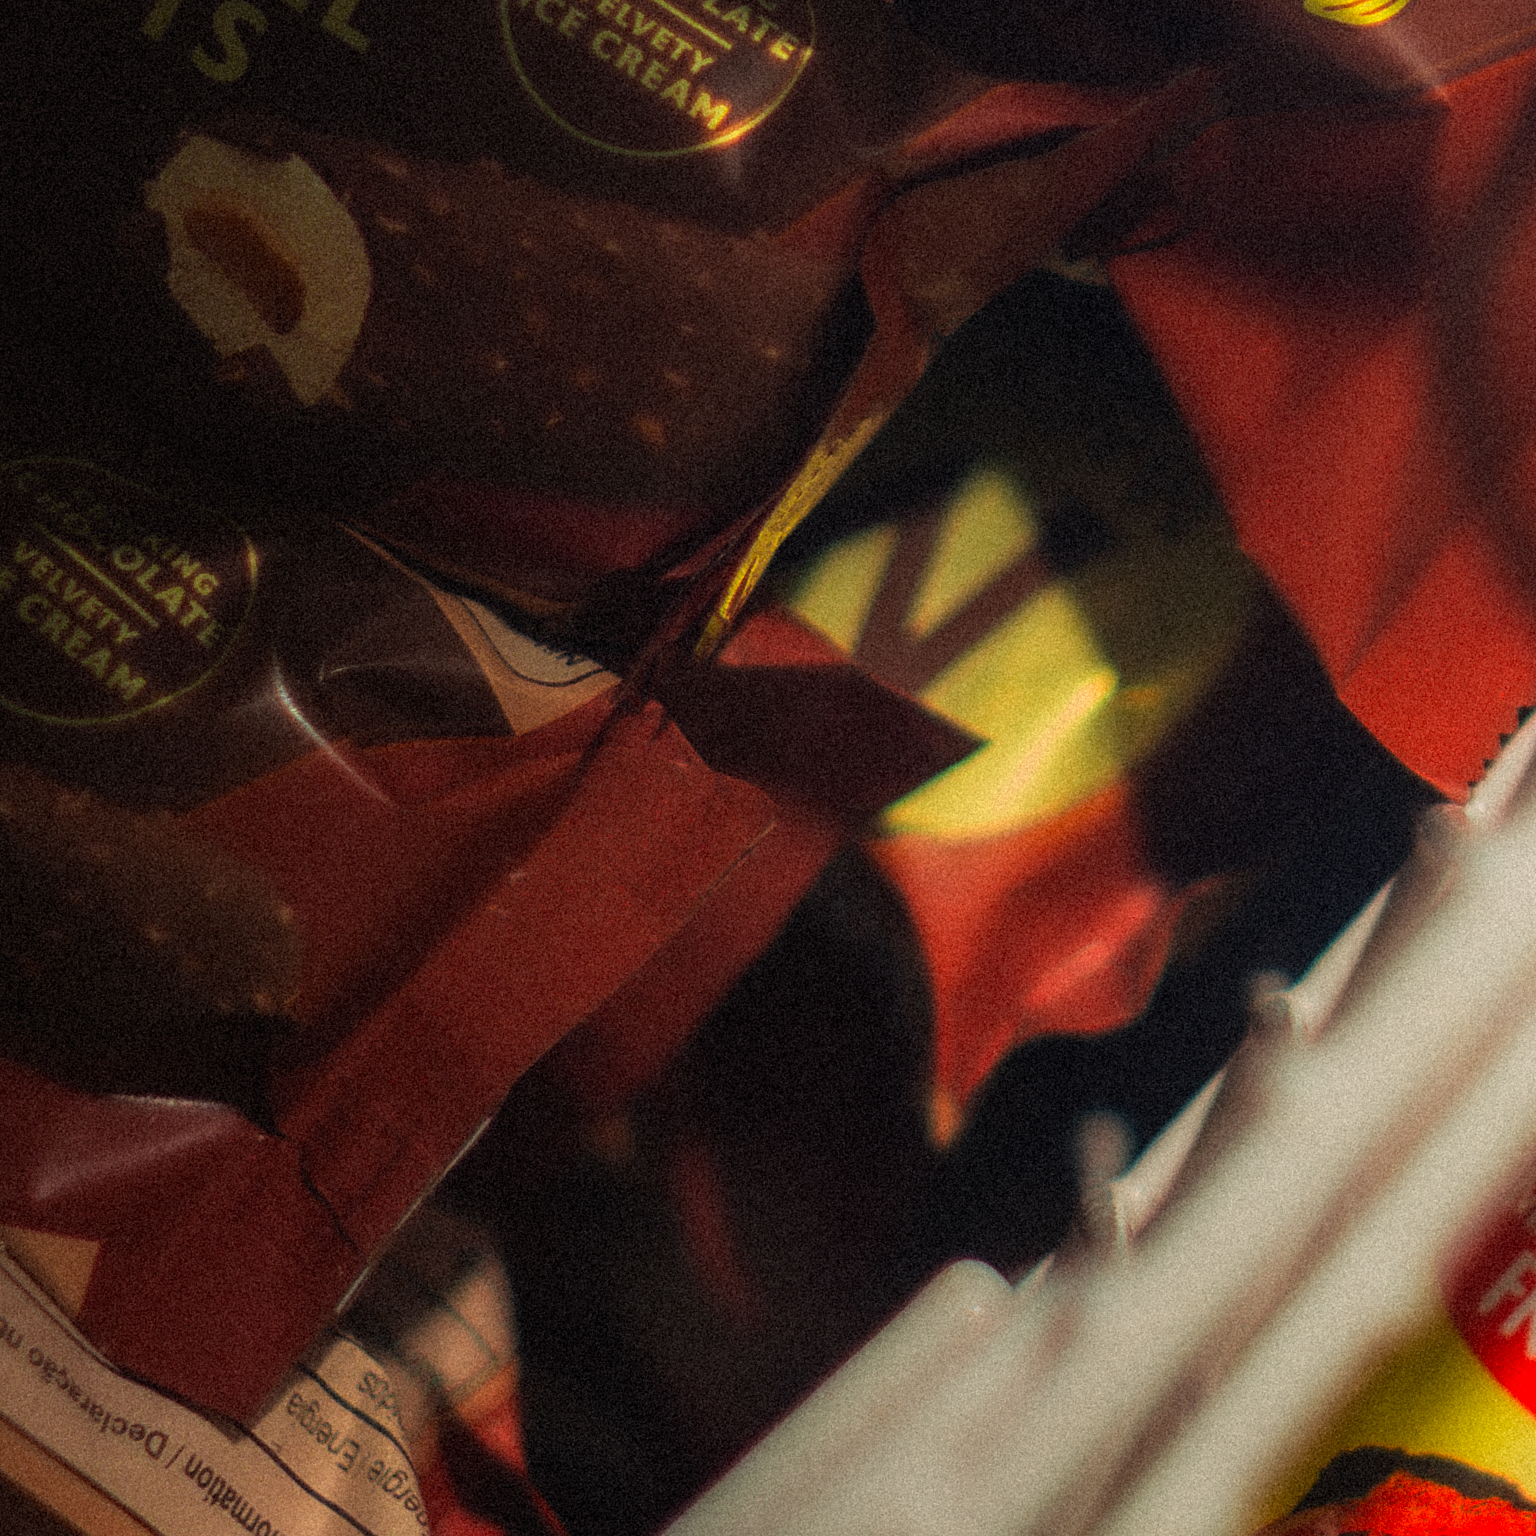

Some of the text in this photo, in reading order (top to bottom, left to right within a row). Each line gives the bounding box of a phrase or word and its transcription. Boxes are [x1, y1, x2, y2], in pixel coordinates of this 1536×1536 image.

[589, 31, 729, 132] CREAM
[12, 540, 141, 644] VELVETY
[17, 593, 148, 702] CREAM
